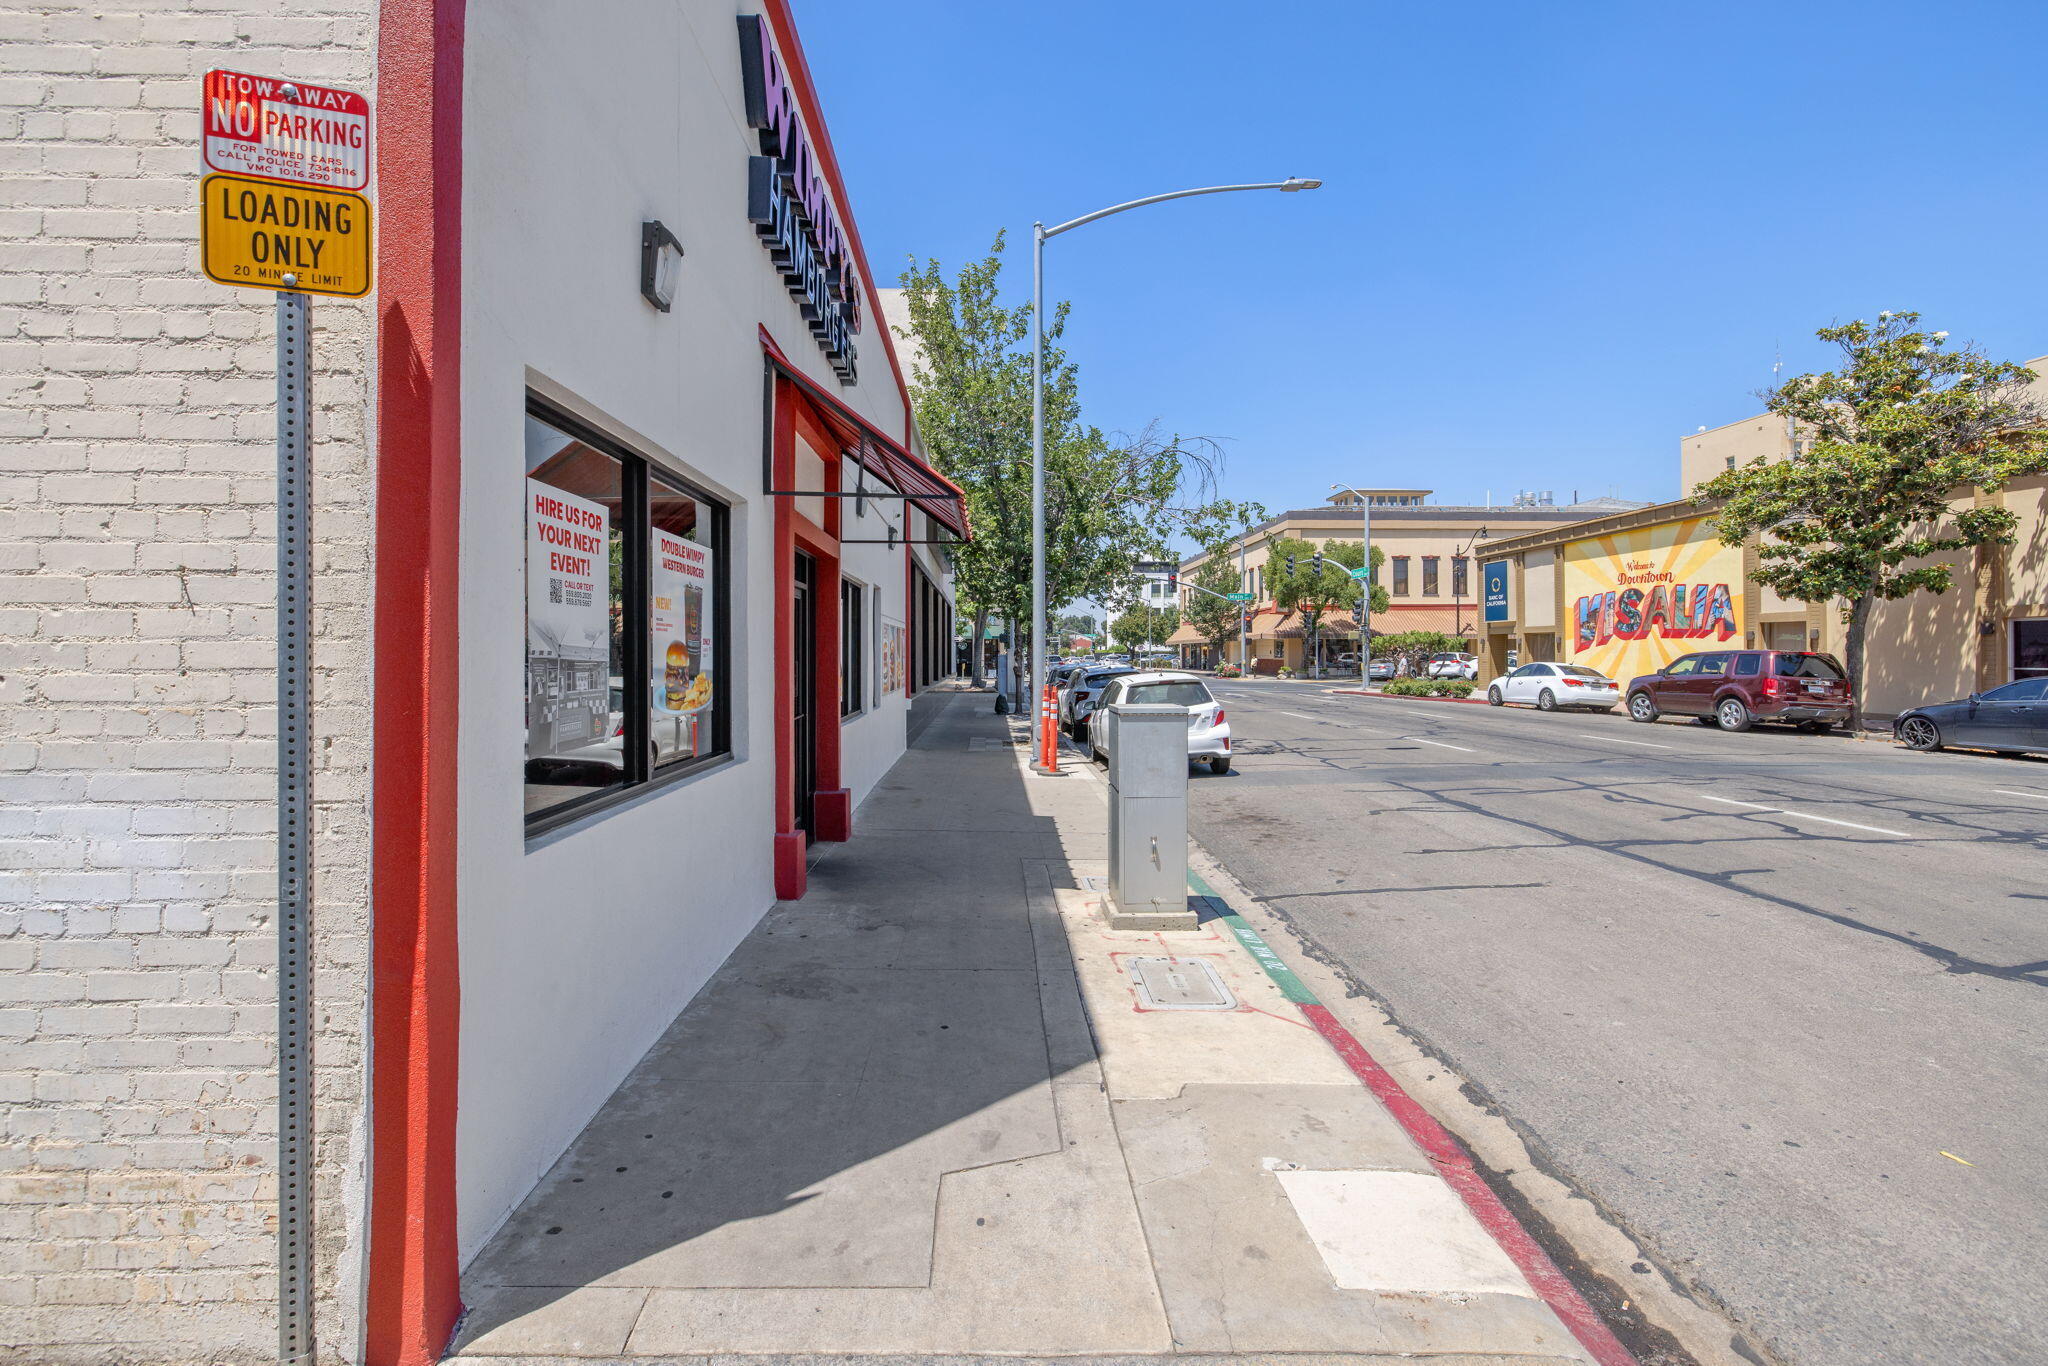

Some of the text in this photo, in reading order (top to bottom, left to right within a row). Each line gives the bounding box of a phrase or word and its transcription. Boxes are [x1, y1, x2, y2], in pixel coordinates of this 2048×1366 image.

[211, 97, 362, 149] NO PARKING
[217, 150, 357, 177] CALL POLICE 734-8116
[232, 143, 342, 167] FOR TOWED CARS
[246, 162, 272, 174] VMC
[223, 187, 352, 235] LOADING
[251, 230, 326, 270] ONLY
[233, 265, 344, 287] 20 MINE LIMIT
[763, 156, 858, 387] HAMBURGERS
[535, 494, 602, 532] HIRE US FOR
[537, 522, 601, 555] YOUR NEXT
[661, 538, 705, 565] DOUBLE WIMPY
[550, 551, 591, 577] EVENT!
[662, 557, 705, 579] WESTERN BURGER
[1617, 570, 1675, 585] Downtown
[564, 579, 594, 592] CALL OR TEXT
[655, 596, 672, 611] NEW!
[1574, 583, 1737, 654] VISALIA
